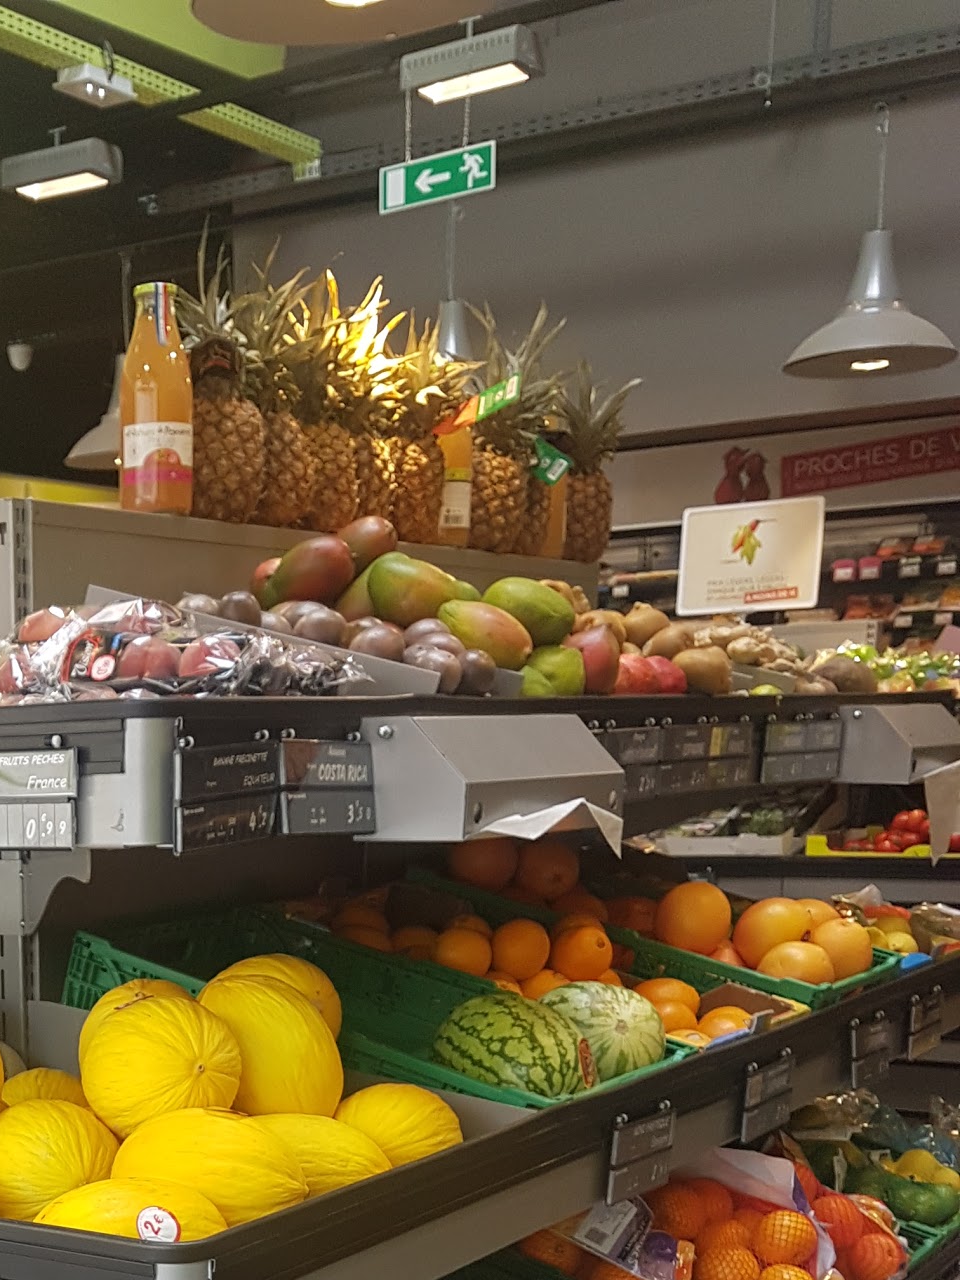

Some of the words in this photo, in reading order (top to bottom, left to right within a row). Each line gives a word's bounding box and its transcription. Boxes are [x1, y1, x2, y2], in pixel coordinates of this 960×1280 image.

[794, 444, 899, 478] PROCHES
[909, 437, 940, 460] DE
[32, 754, 65, 764] PECHES
[243, 772, 275, 786] EQUATEUR
[318, 763, 346, 781] COSTA
[348, 764, 367, 781] RICA
[26, 775, 67, 790] France
